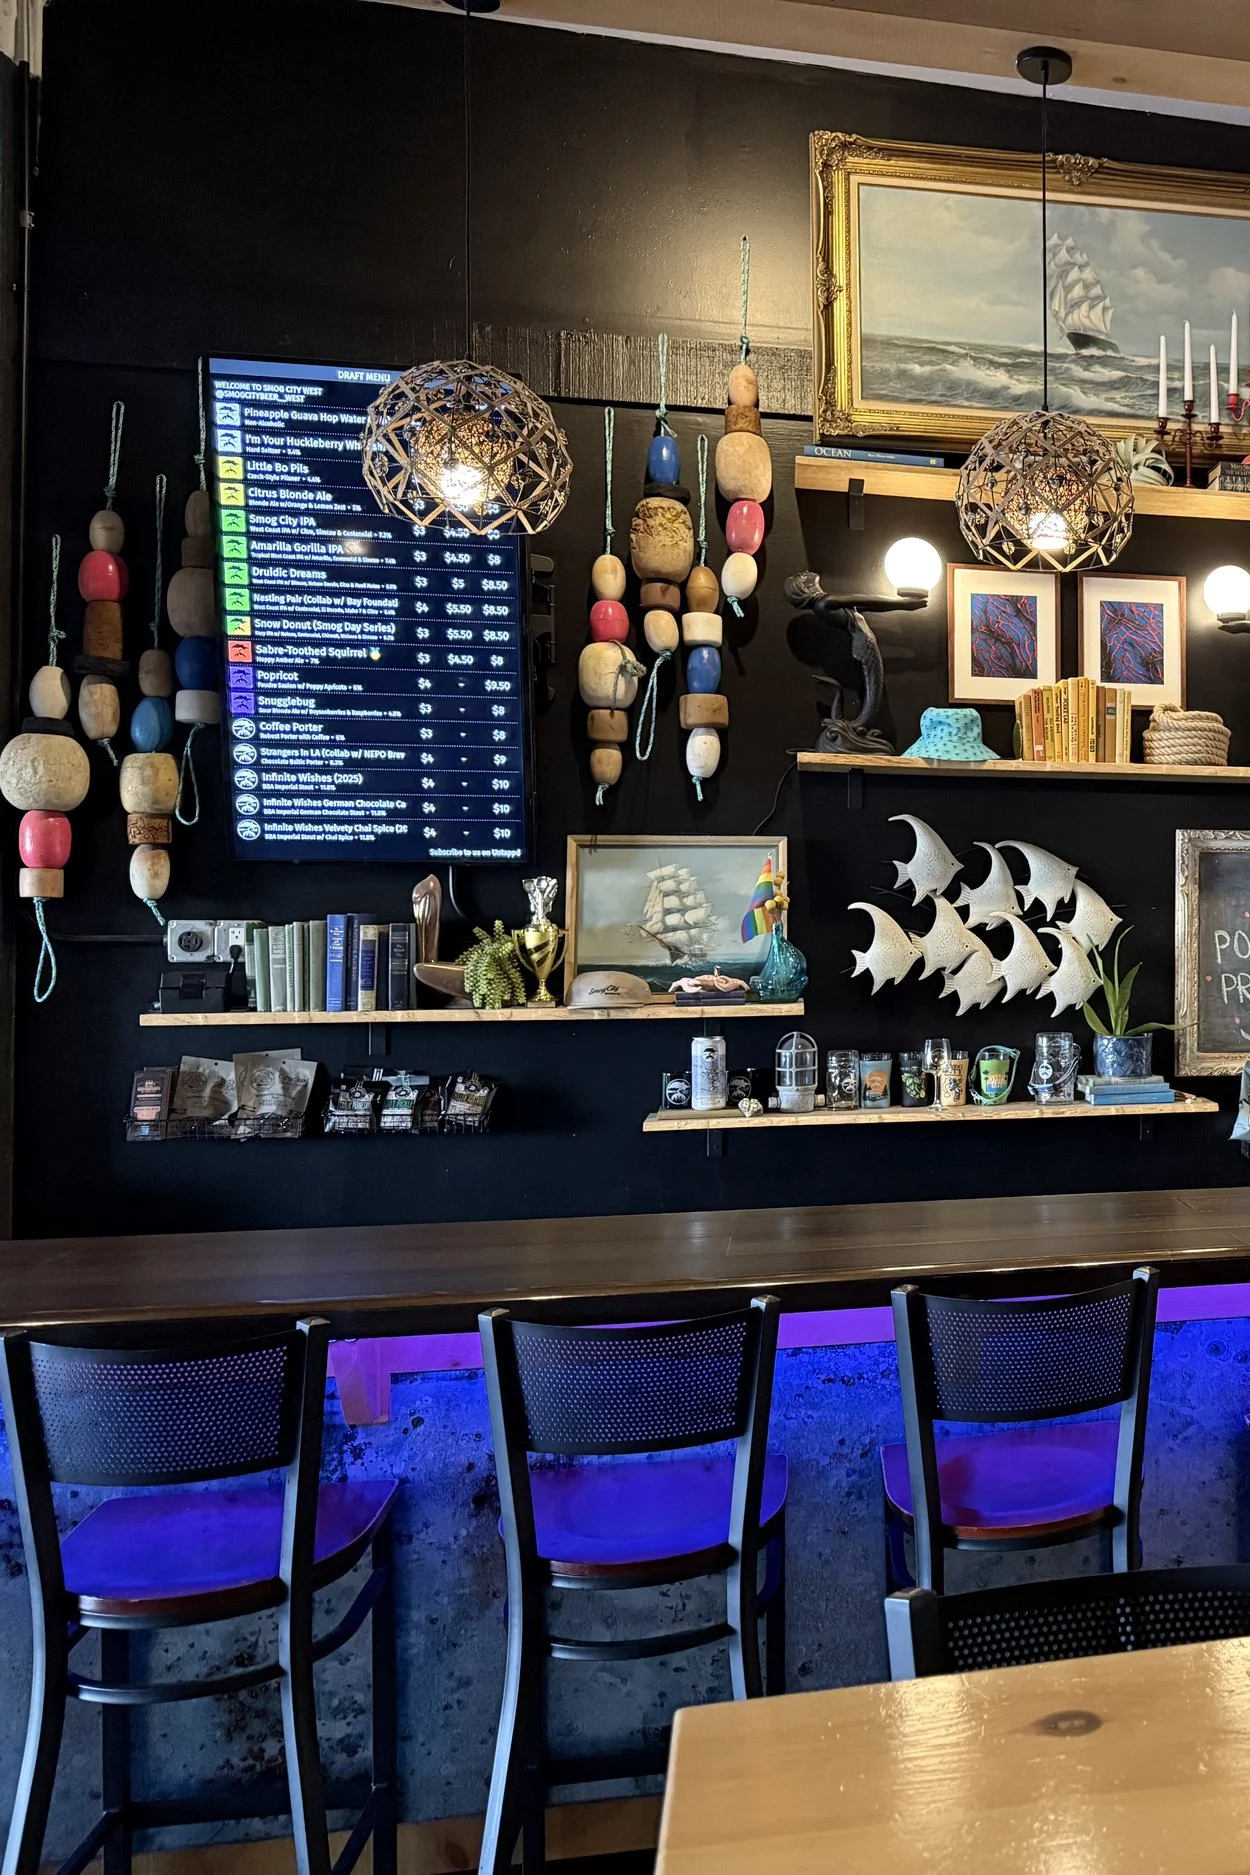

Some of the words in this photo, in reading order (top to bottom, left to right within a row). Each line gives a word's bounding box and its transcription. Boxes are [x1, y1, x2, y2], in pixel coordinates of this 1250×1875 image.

[338, 370, 364, 381] DRAFT
[366, 372, 390, 382] MENU
[215, 381, 250, 391] WELCOME
[252, 383, 262, 391] TO
[263, 384, 285, 392] SMOG
[286, 386, 302, 394] CITY
[303, 387, 323, 396] WEST
[245, 408, 289, 420] Pineapple
[291, 411, 318, 421] Guava
[320, 412, 338, 424] Hop
[340, 413, 366, 424] Water
[246, 434, 261, 444] I'm
[262, 435, 284, 445] Your
[286, 436, 343, 452] Huckleberry
[814, 447, 852, 458] OCEAN
[247, 460, 272, 472] Little
[275, 462, 288, 472] Bo
[290, 463, 309, 474] Pils
[248, 488, 278, 498] Citrus
[280, 489, 314, 500] Blonde
[316, 491, 332, 501] Ale
[249, 514, 278, 526] Smog
[279, 516, 298, 526] City
[300, 516, 316, 526] IPA
[412, 525, 426, 537] $3
[251, 540, 292, 552] Amarilla
[293, 542, 326, 553] Gorilla
[328, 544, 344, 554] IPA
[414, 550, 426, 562] $3
[444, 552, 471, 564] $4.50
[488, 554, 500, 566] $8
[252, 566, 288, 578] Druidic
[290, 568, 327, 579] Dreams
[415, 576, 428, 588] $3
[452, 577, 464, 590] $5
[482, 578, 508, 591] $8.50
[253, 592, 285, 604] Nesting
[286, 594, 302, 604] Pair
[304, 594, 332, 606] (Collab
[334, 595, 345, 606] w/
[346, 596, 362, 608] Bay
[363, 596, 398, 608] Foundati
[416, 601, 429, 614] $4
[446, 602, 472, 615] $5.50
[483, 604, 509, 616] $8.50
[254, 618, 280, 629] Snow
[282, 620, 312, 630] Donut
[313, 620, 343, 632] (Smog
[344, 622, 361, 633] Day
[363, 622, 396, 633] Series)
[417, 626, 430, 639] $3
[447, 628, 473, 640] $5.50
[483, 629, 510, 641] $8.50
[256, 644, 327, 656] Sabre-Toothed
[328, 647, 367, 659] Squirrel
[417, 652, 430, 664] $3
[448, 653, 474, 665] $4.50
[490, 655, 504, 667] $8
[258, 670, 299, 682] Popricot
[418, 678, 432, 690] $4
[485, 680, 510, 692] $9.50
[258, 696, 316, 708] Snugglebug
[419, 703, 432, 715] $3
[492, 705, 505, 717] $8
[259, 722, 290, 732] Coffee
[292, 722, 324, 732] Porter
[420, 728, 433, 740] $3
[492, 729, 506, 742] $8
[260, 748, 299, 758] Strangers
[310, 749, 321, 757] LA
[322, 748, 350, 759] (Collab
[351, 749, 362, 759] w/
[364, 750, 386, 759] NEPO
[421, 752, 434, 764] $4
[494, 754, 506, 766] $9
[262, 773, 296, 782] Infinite
[299, 773, 332, 783] Wishes
[334, 773, 363, 785] (2025)
[422, 777, 435, 789] $4
[492, 778, 510, 791] $10
[264, 798, 292, 807] Infinite
[293, 799, 322, 807] Wishes
[323, 799, 354, 808] German
[356, 799, 395, 808] Chocolate
[396, 800, 406, 809] Ca
[422, 802, 436, 814] $4
[493, 803, 510, 815] $10
[264, 823, 293, 832] Infinite
[294, 824, 323, 832] Wishes
[324, 824, 353, 834] Velvety
[354, 824, 371, 832] Chai
[372, 824, 395, 834] Spice
[423, 827, 437, 839] $4
[493, 828, 511, 839] $10
[429, 848, 463, 857] Subscribe
[463, 849, 472, 857] to
[491, 848, 521, 858] Untappd
